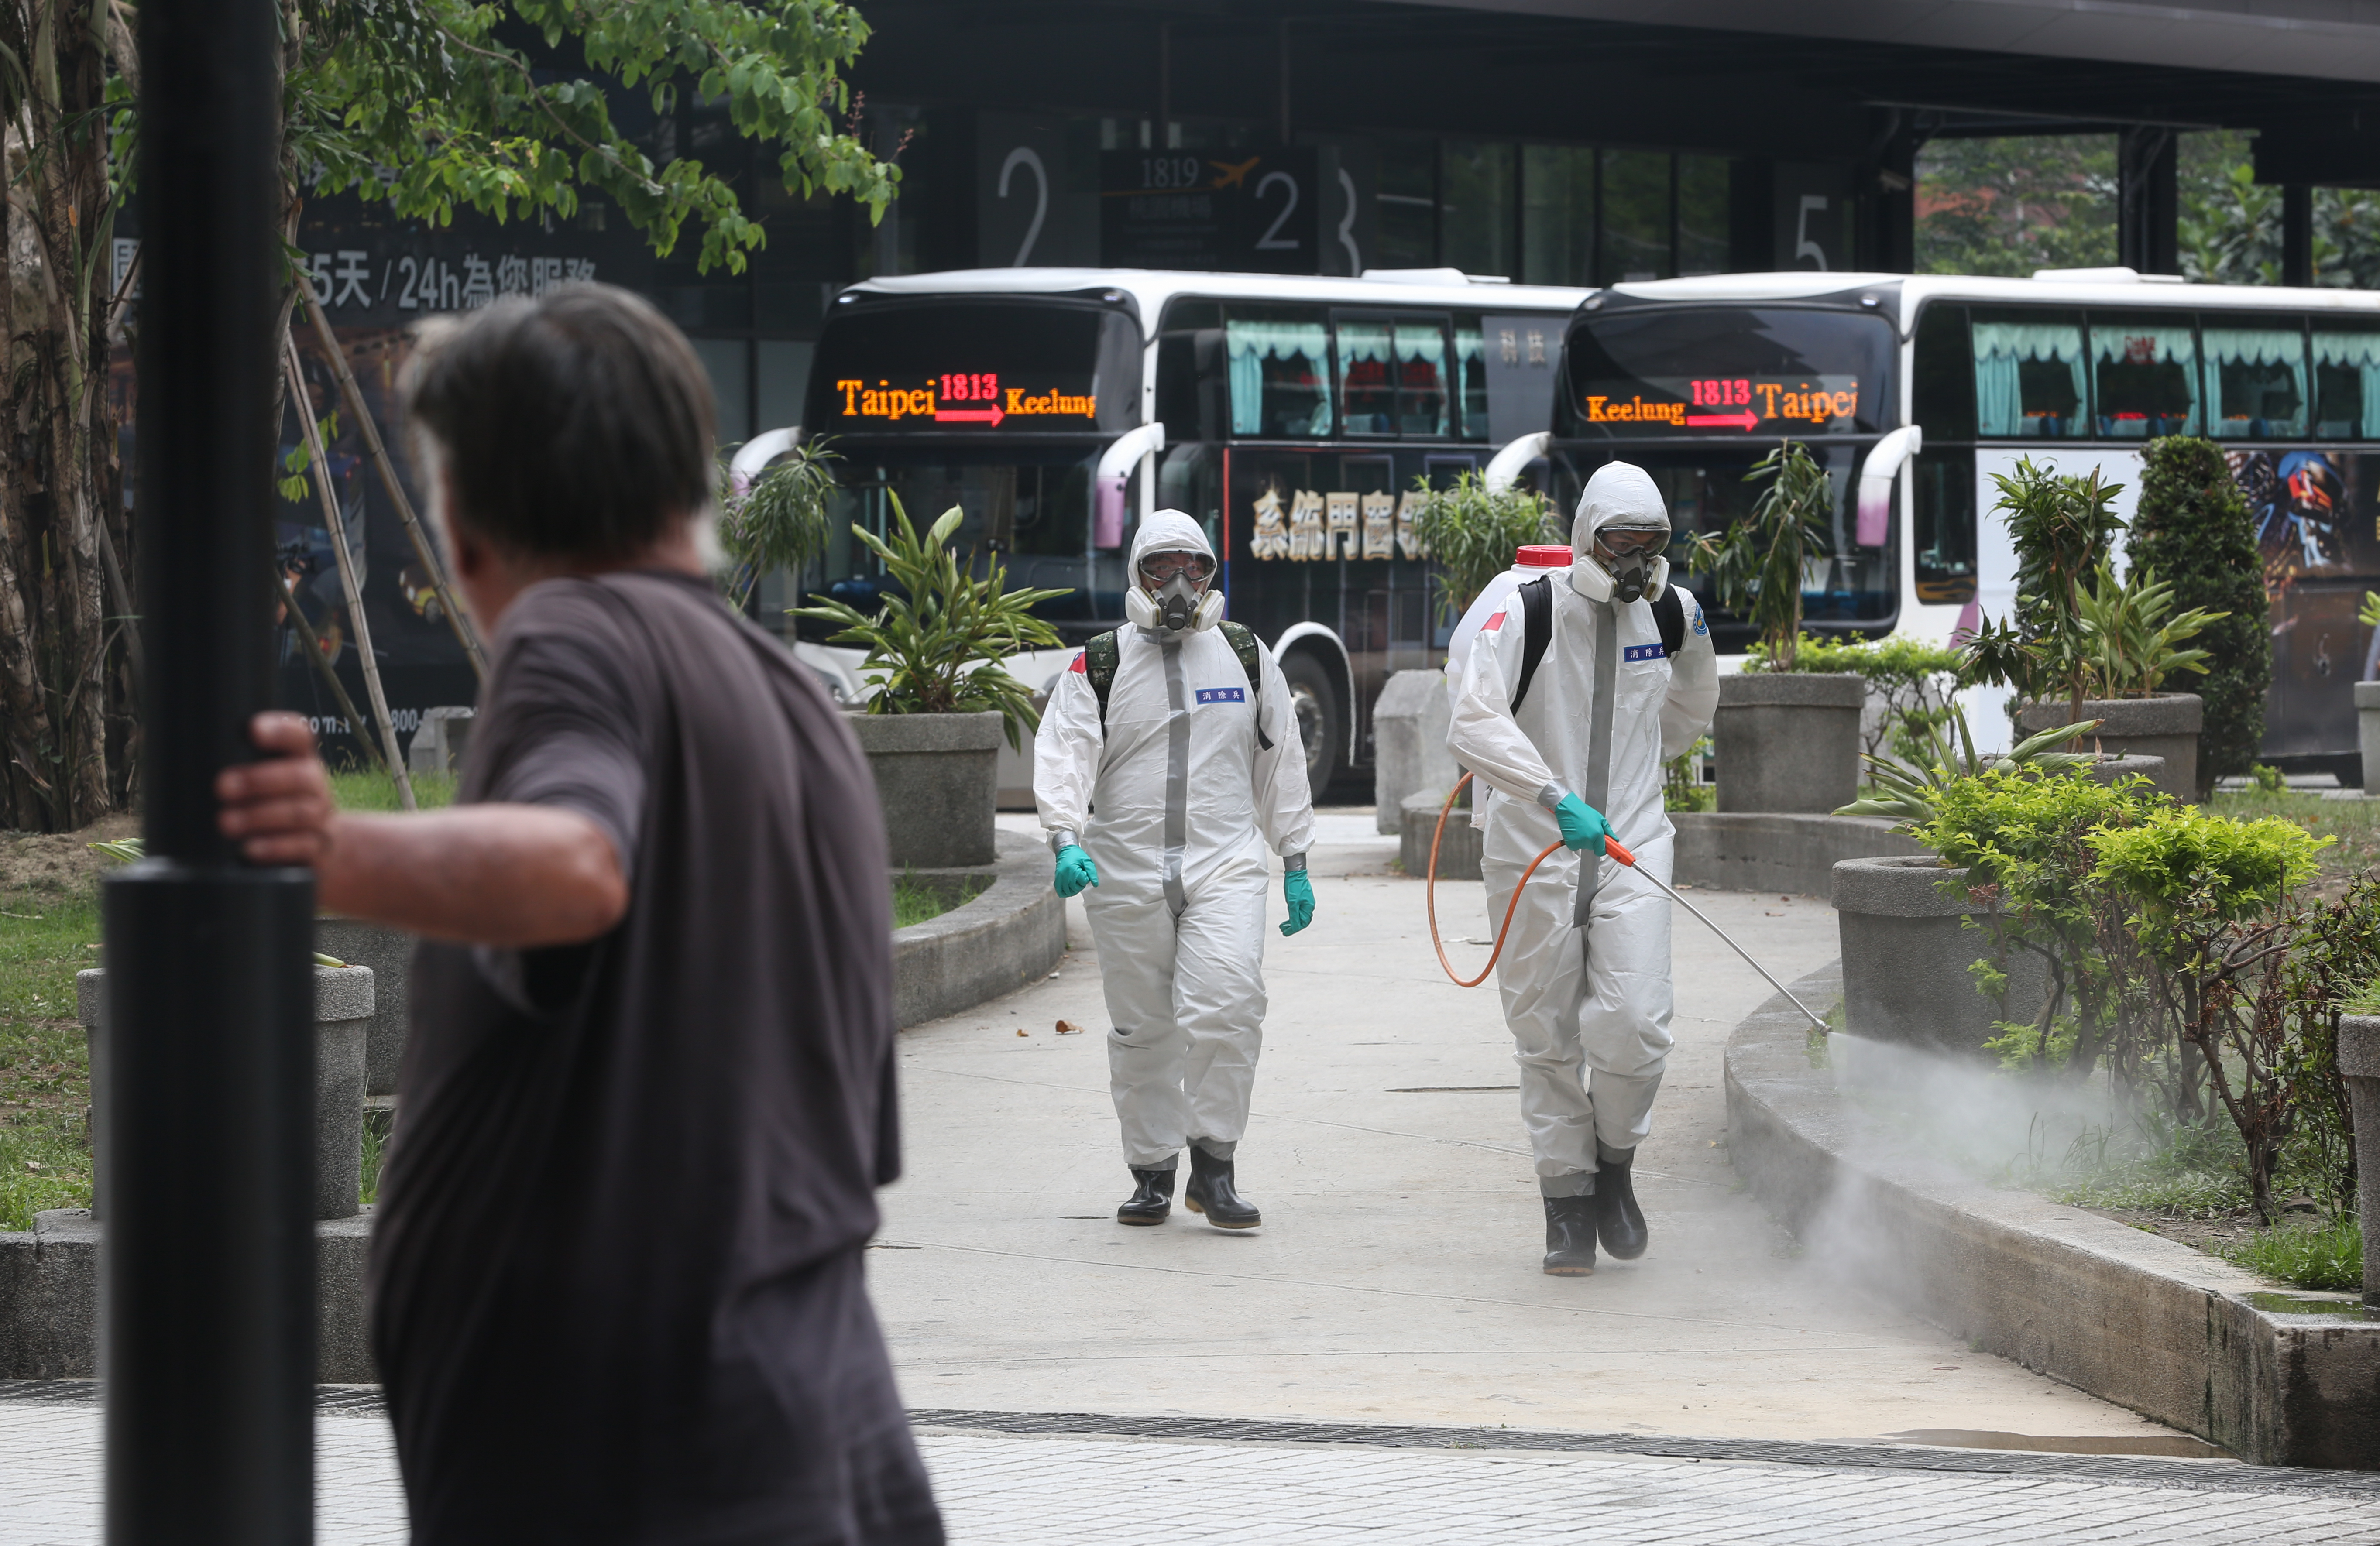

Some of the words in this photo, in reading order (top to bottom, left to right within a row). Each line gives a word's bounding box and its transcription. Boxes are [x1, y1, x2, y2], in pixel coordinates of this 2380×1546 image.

[1141, 157, 1199, 188] 1819
[1255, 171, 1299, 249] 2
[836, 379, 936, 420] Taipei
[940, 374, 999, 401] 1813
[1004, 388, 1097, 419] Keelung
[1586, 395, 1686, 425] Keelung
[1690, 379, 1751, 406] 1813
[1755, 382, 1858, 423] Taipei
[1630, 646, 1664, 658] 消除兵
[1202, 690, 1240, 700] 消除兵
